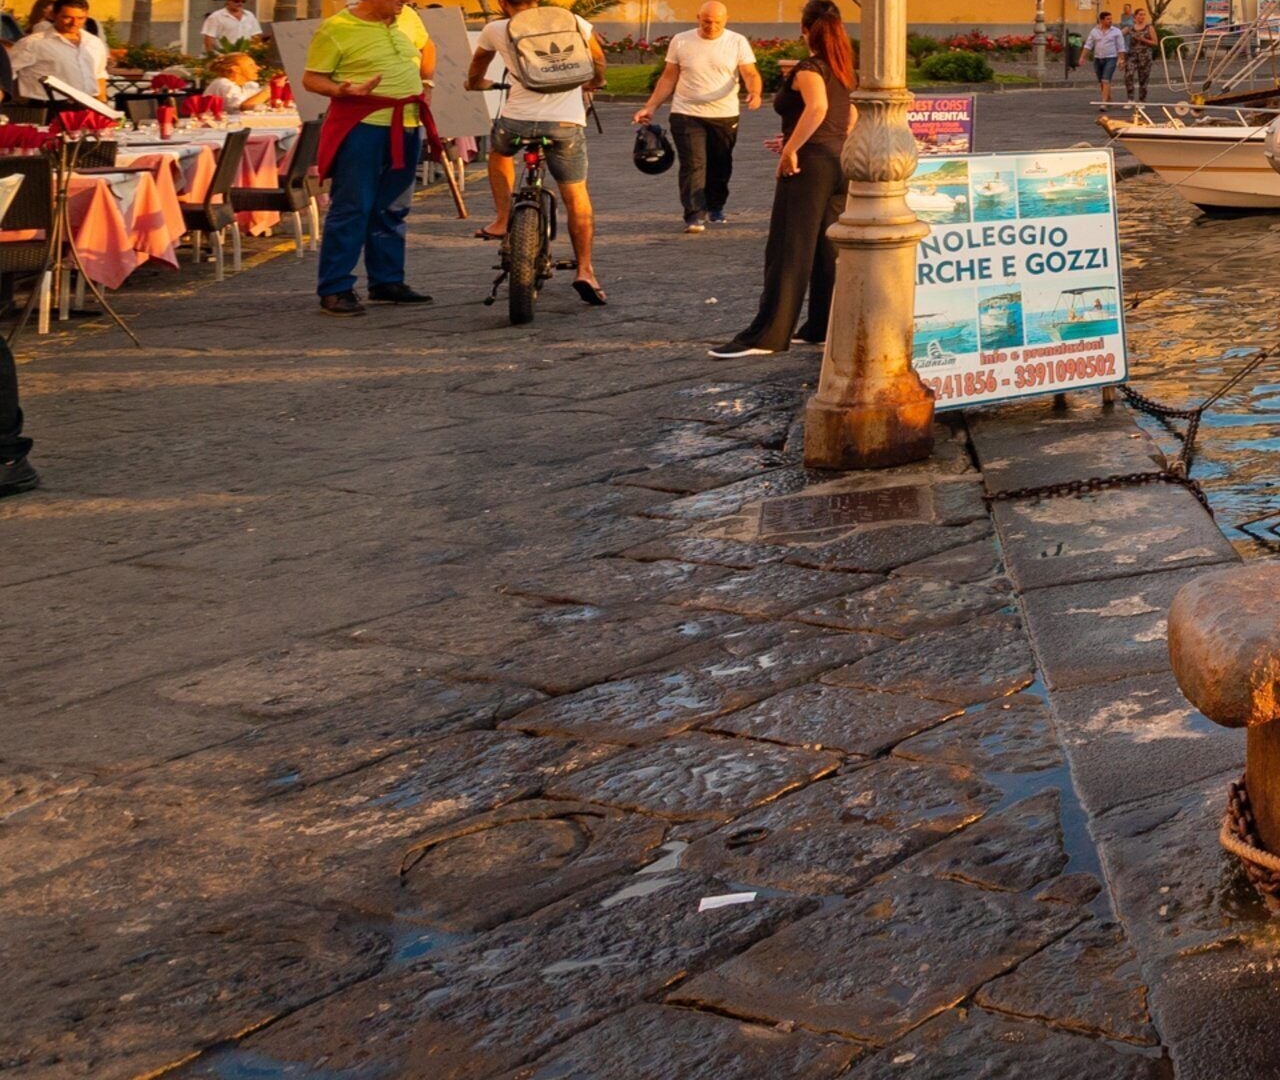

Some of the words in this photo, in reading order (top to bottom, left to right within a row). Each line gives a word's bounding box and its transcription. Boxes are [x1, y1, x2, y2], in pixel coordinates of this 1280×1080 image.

[540, 62, 581, 73] adidas
[935, 99, 969, 111] COAST
[931, 111, 971, 121] RENTAL
[920, 224, 1068, 260] NOLEGGIO
[915, 258, 993, 286] RCHE
[1002, 255, 1017, 278] E
[1025, 247, 1109, 275] GOZZI
[980, 349, 1008, 366] Info
